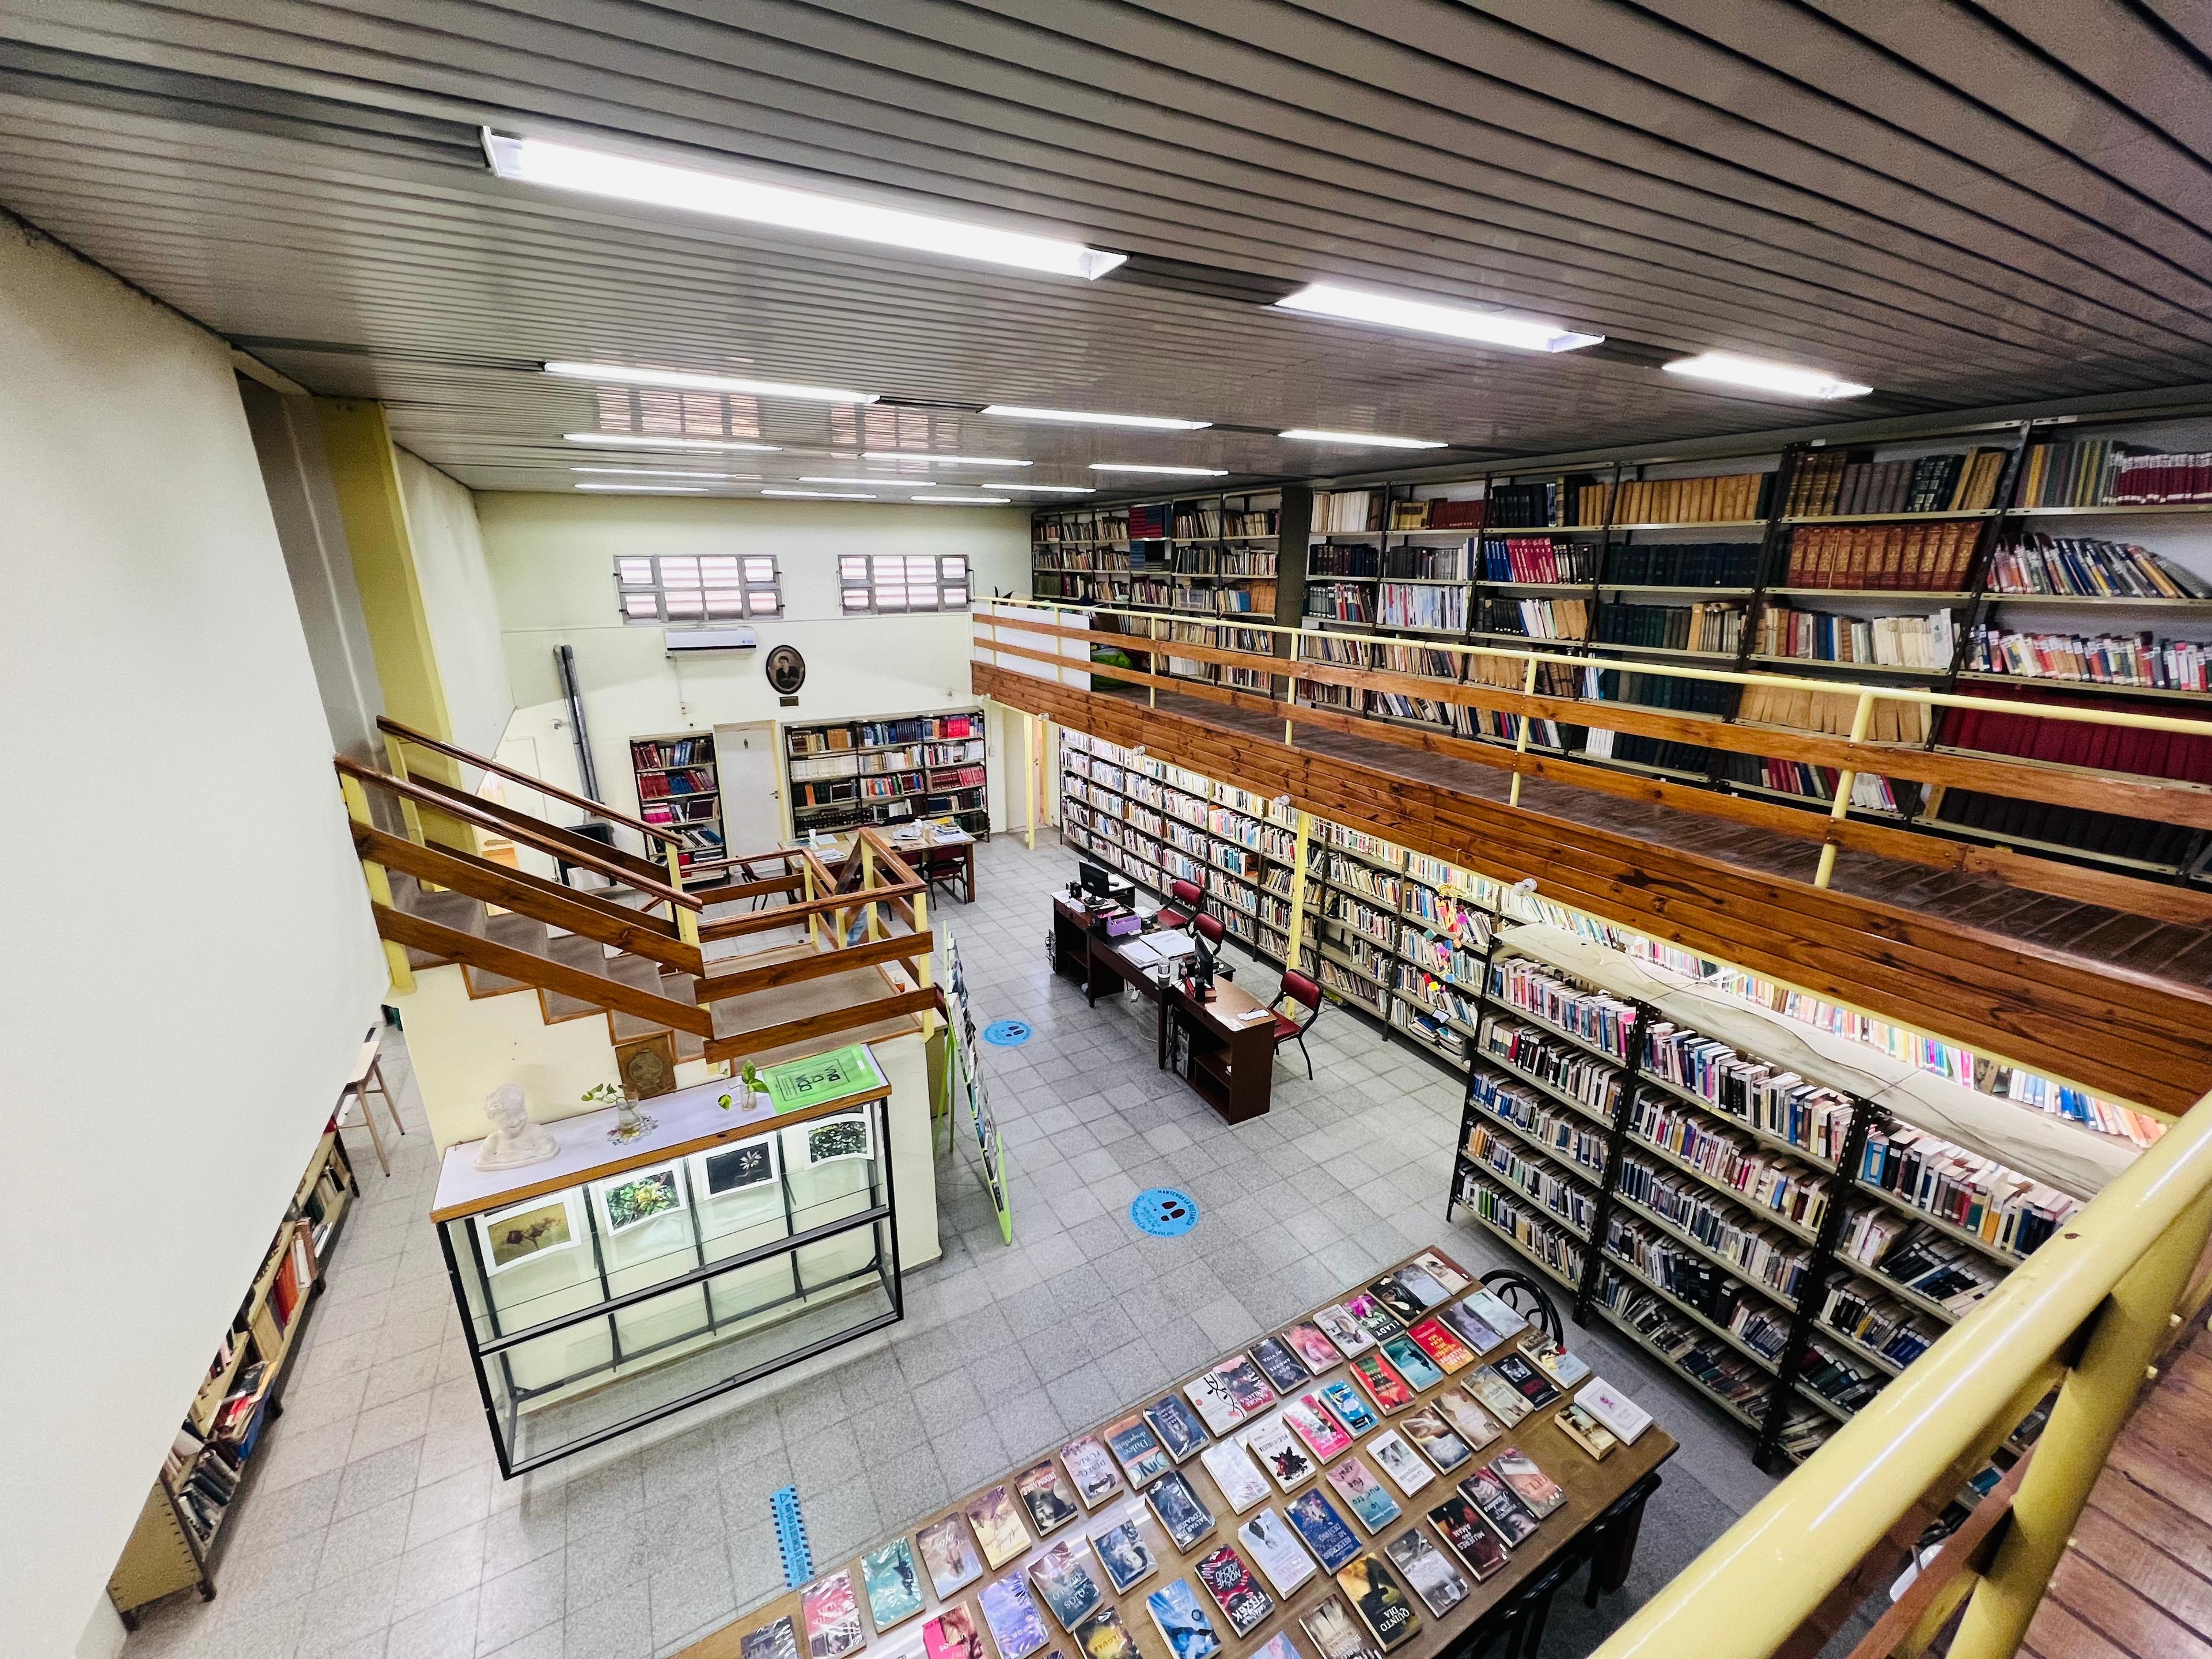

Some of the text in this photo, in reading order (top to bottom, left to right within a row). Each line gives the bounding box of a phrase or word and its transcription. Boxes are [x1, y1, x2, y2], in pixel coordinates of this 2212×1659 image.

[1157, 1190, 1185, 1200] MANTENGA
[1185, 1204, 1196, 1226] DISTANCIA
[1375, 1322, 1396, 1336] LADY
[1438, 1346, 1463, 1364] ALLENDE
[1123, 1438, 1149, 1457] Dulce
[1020, 1471, 1056, 1497] INDOMABLE
[1347, 1477, 1365, 1491] fue
[1452, 1522, 1471, 1537] AMAN
[1456, 1530, 1484, 1551] MUJERES
[1217, 1568, 1240, 1589] NOCHE
[1378, 1606, 1410, 1632] QUINTO
